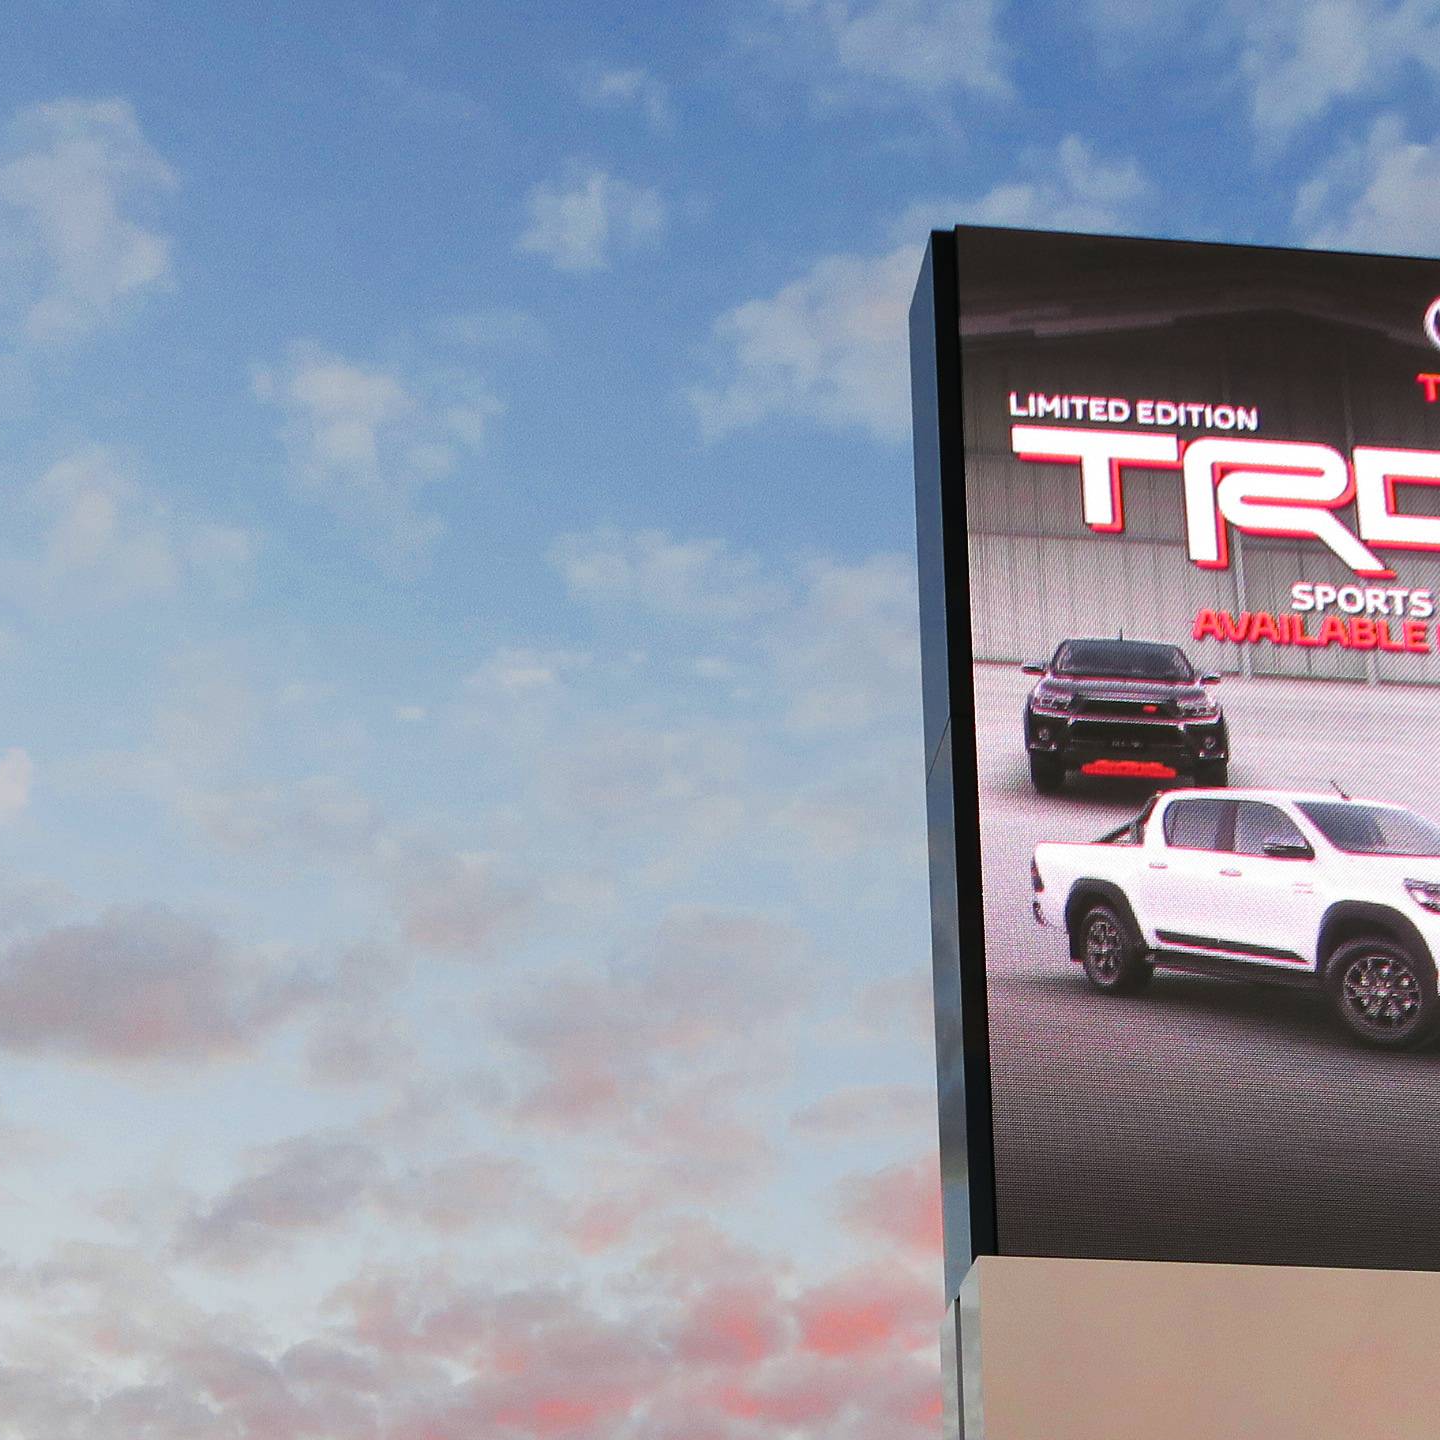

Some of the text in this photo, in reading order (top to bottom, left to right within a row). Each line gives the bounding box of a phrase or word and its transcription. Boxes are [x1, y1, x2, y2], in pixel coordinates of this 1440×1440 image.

[1009, 392, 1259, 432] LIMITED EDITION
[1291, 581, 1432, 619] SPORTS
[1192, 606, 1426, 655] AVAILABLE
